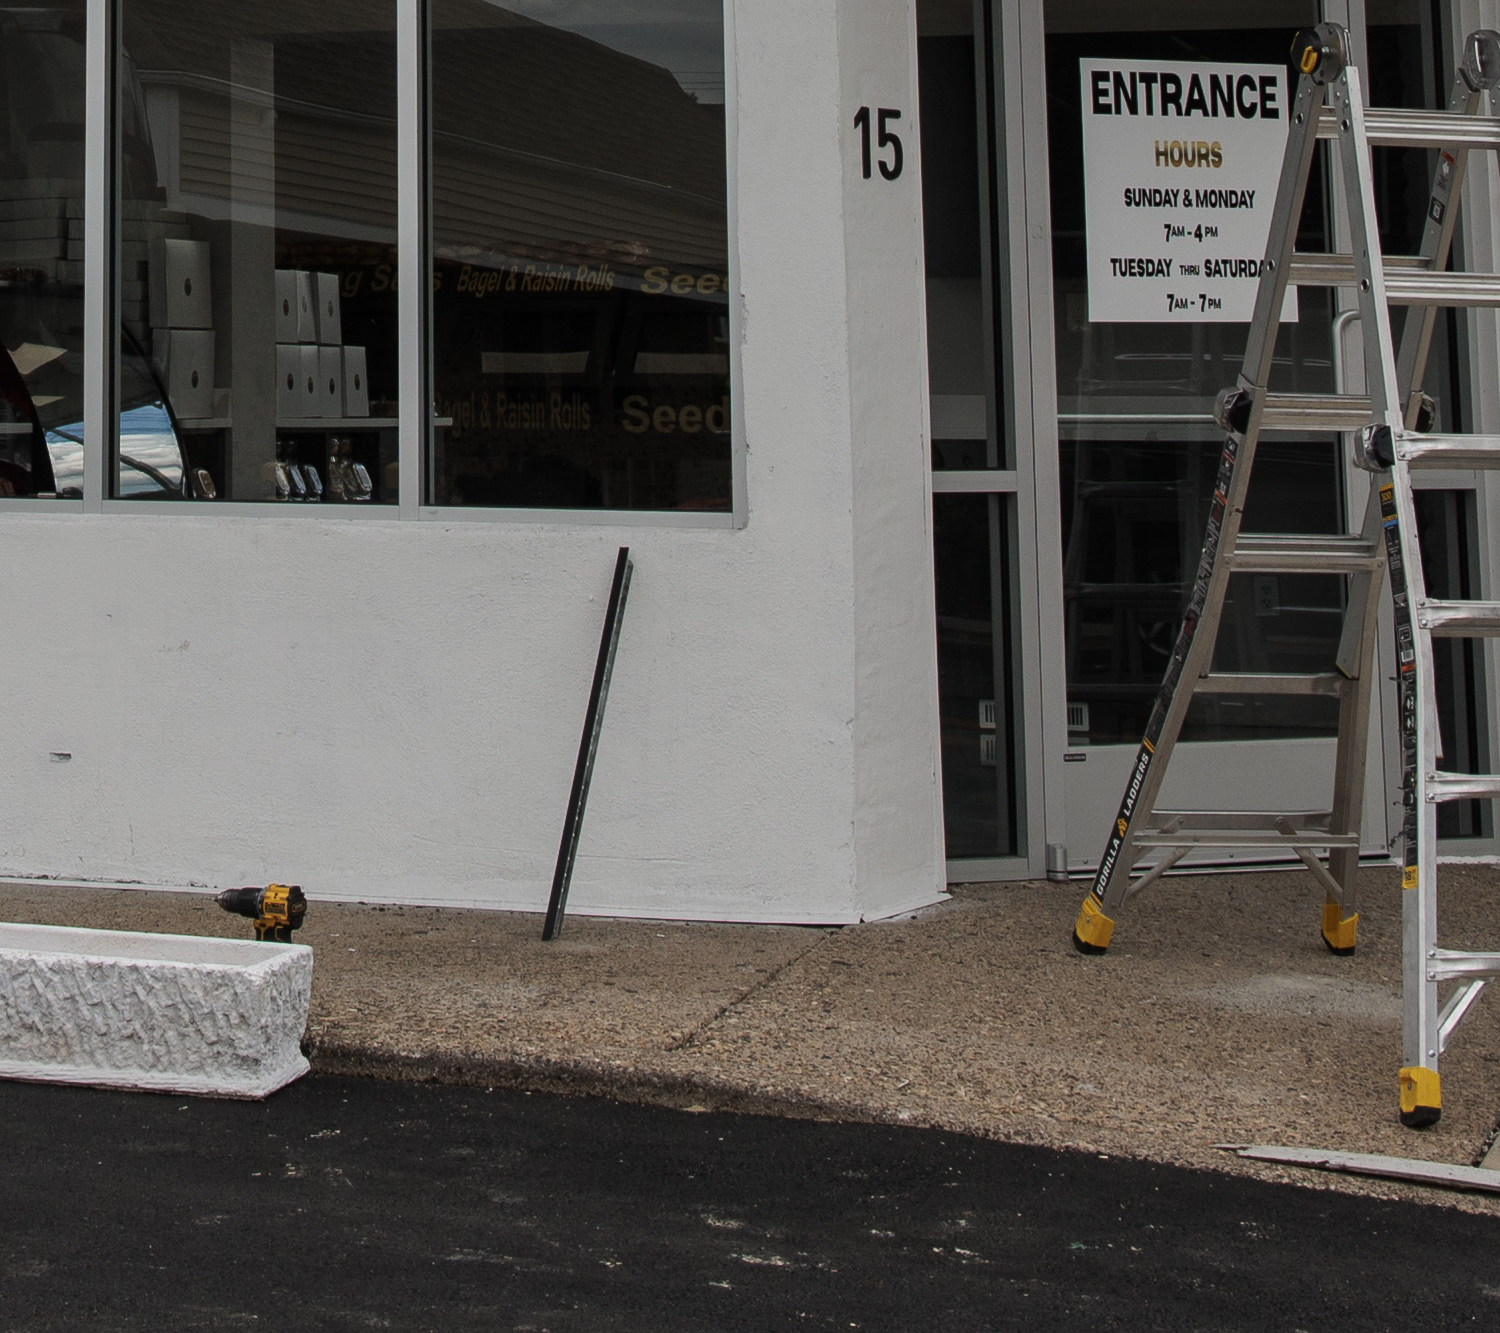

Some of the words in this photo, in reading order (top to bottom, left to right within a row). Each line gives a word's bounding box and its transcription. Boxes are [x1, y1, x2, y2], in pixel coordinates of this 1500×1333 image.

[1090, 70, 1280, 120] ENTRANCE
[852, 105, 903, 182] 15
[1154, 139, 1223, 169] HOURS
[1123, 187, 1180, 208] SUNDAY
[1182, 189, 1194, 208] &
[1195, 189, 1256, 209] MONDAY
[456, 264, 502, 298] Bagel
[505, 266, 516, 292] &
[520, 264, 572, 293] Raisin
[573, 263, 616, 293] Rolls
[1110, 258, 1173, 278] TUESDAY
[1179, 264, 1200, 277] THRU
[1204, 259, 1265, 278] SATURDA
[496, 393, 545, 430] Raisin
[549, 391, 591, 430] Rolls
[1123, 753, 1149, 817] LADDERS
[1096, 838, 1121, 896] GORILLA
